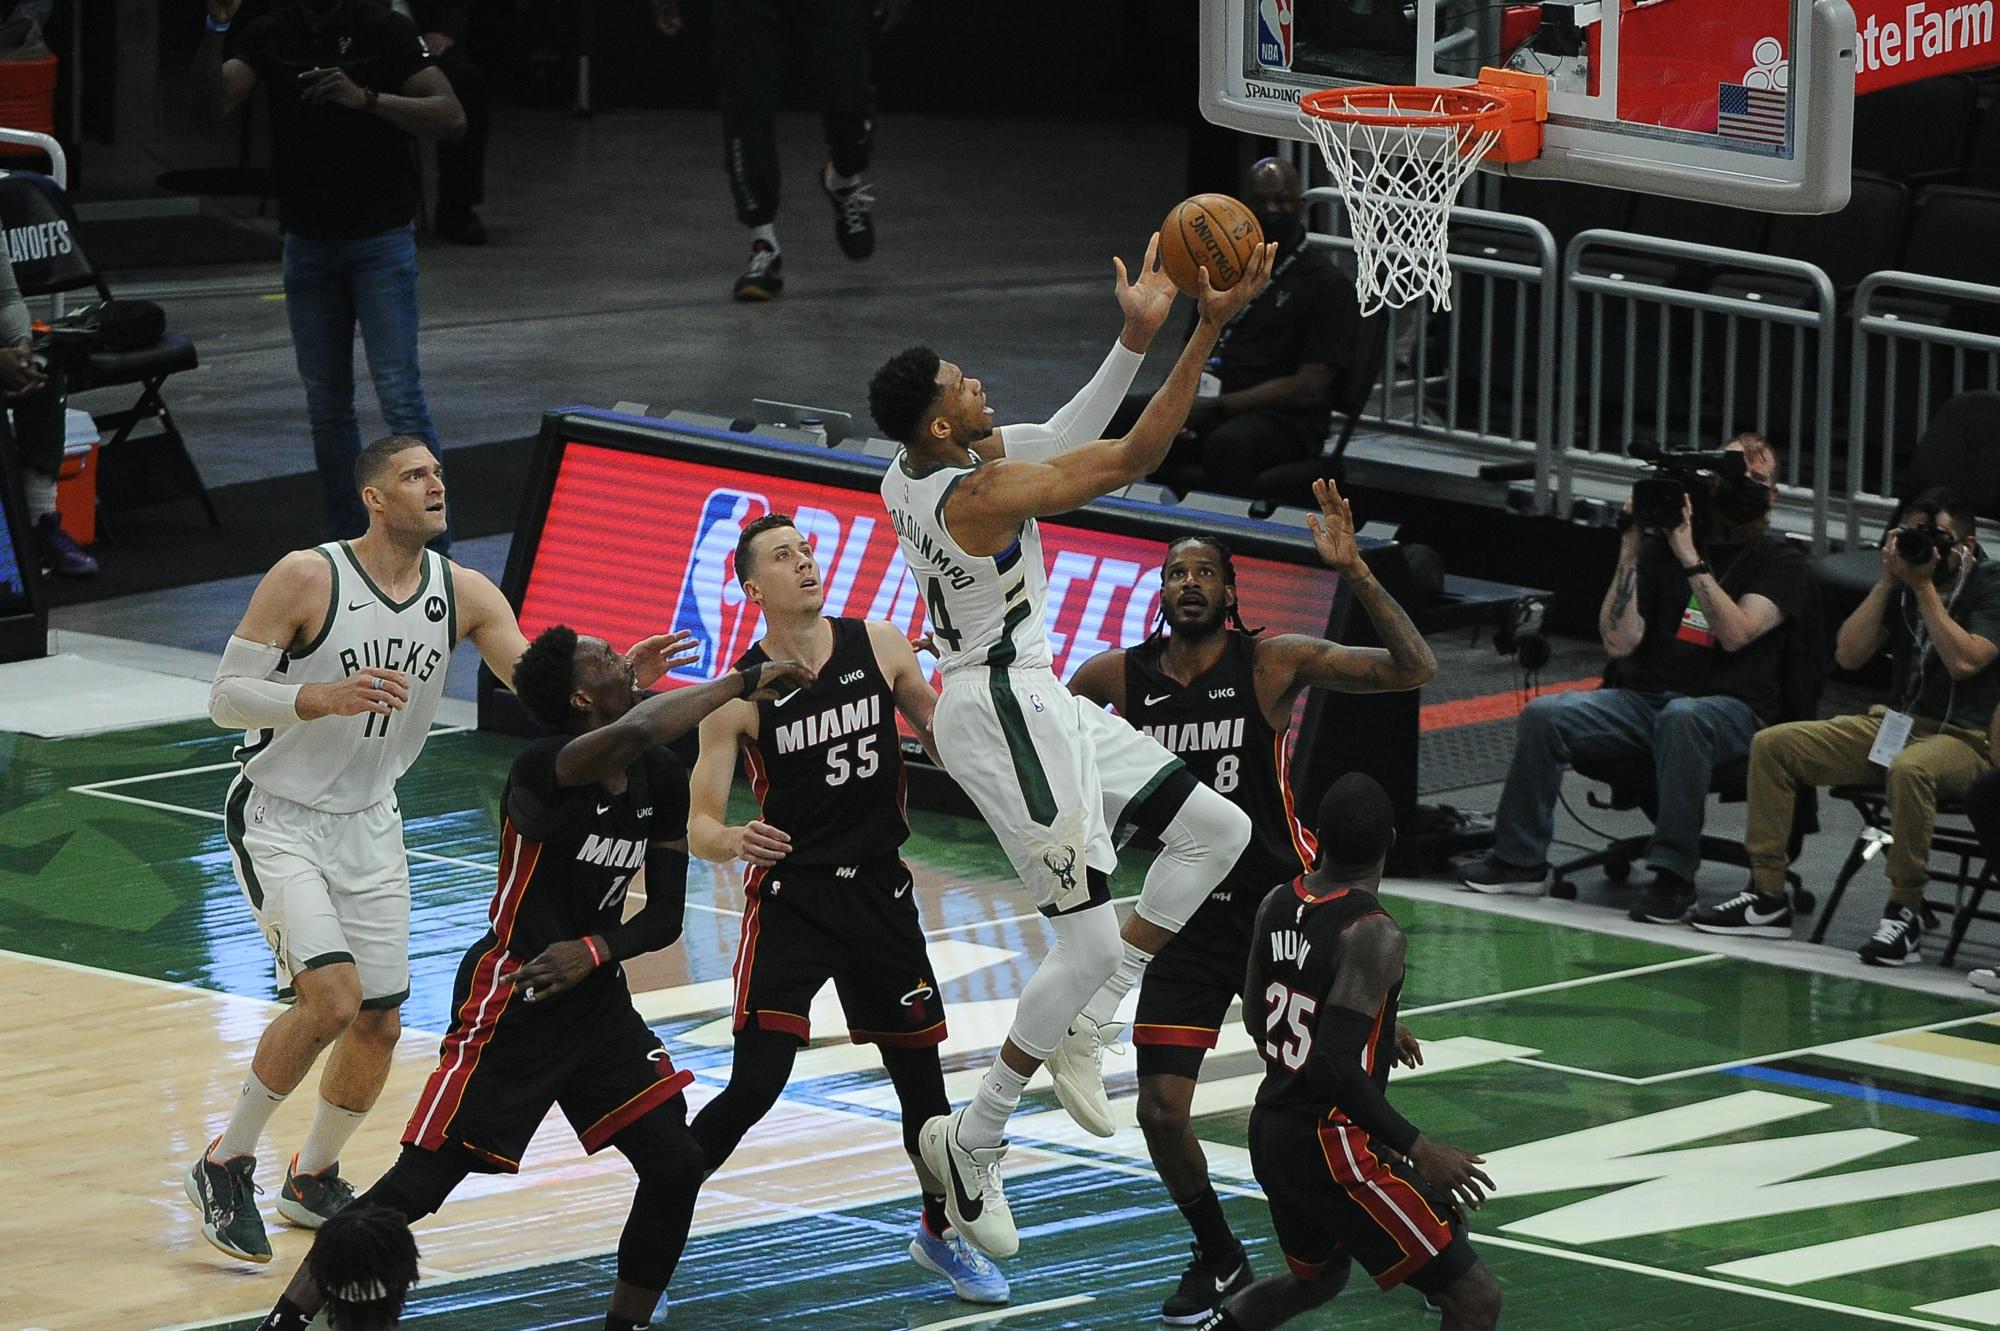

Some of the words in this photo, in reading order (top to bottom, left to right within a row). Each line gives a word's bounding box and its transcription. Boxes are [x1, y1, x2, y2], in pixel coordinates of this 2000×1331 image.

[1261, 43, 1279, 62] NBA
[1245, 82, 1301, 105] SPALDING
[1189, 212, 1239, 283] SPALDING
[889, 508, 976, 590] OKOUNMPO
[927, 576, 963, 652] 4
[775, 694, 880, 754] MIAMI
[1142, 717, 1245, 752] MIAMI
[825, 733, 879, 787] 55
[1214, 754, 1240, 793] 8
[1265, 981, 1316, 1071] 25
